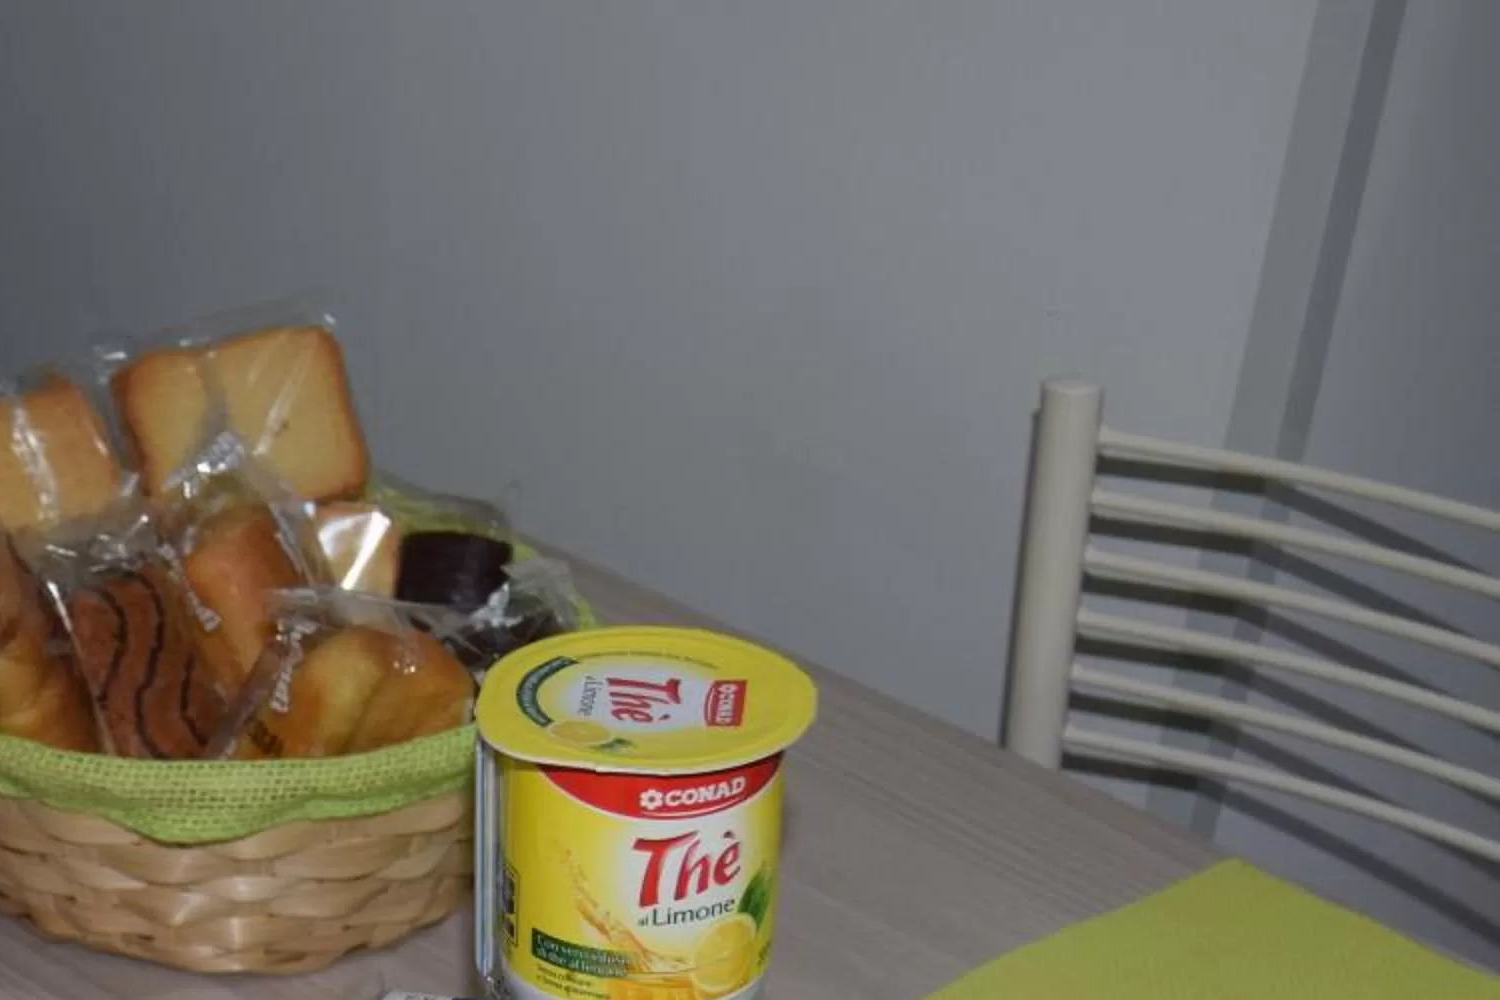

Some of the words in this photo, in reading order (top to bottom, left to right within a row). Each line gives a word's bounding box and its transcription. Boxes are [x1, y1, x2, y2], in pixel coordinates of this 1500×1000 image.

[662, 776, 747, 807] CONAD
[632, 829, 742, 909] Thè
[652, 898, 736, 928] Limone
